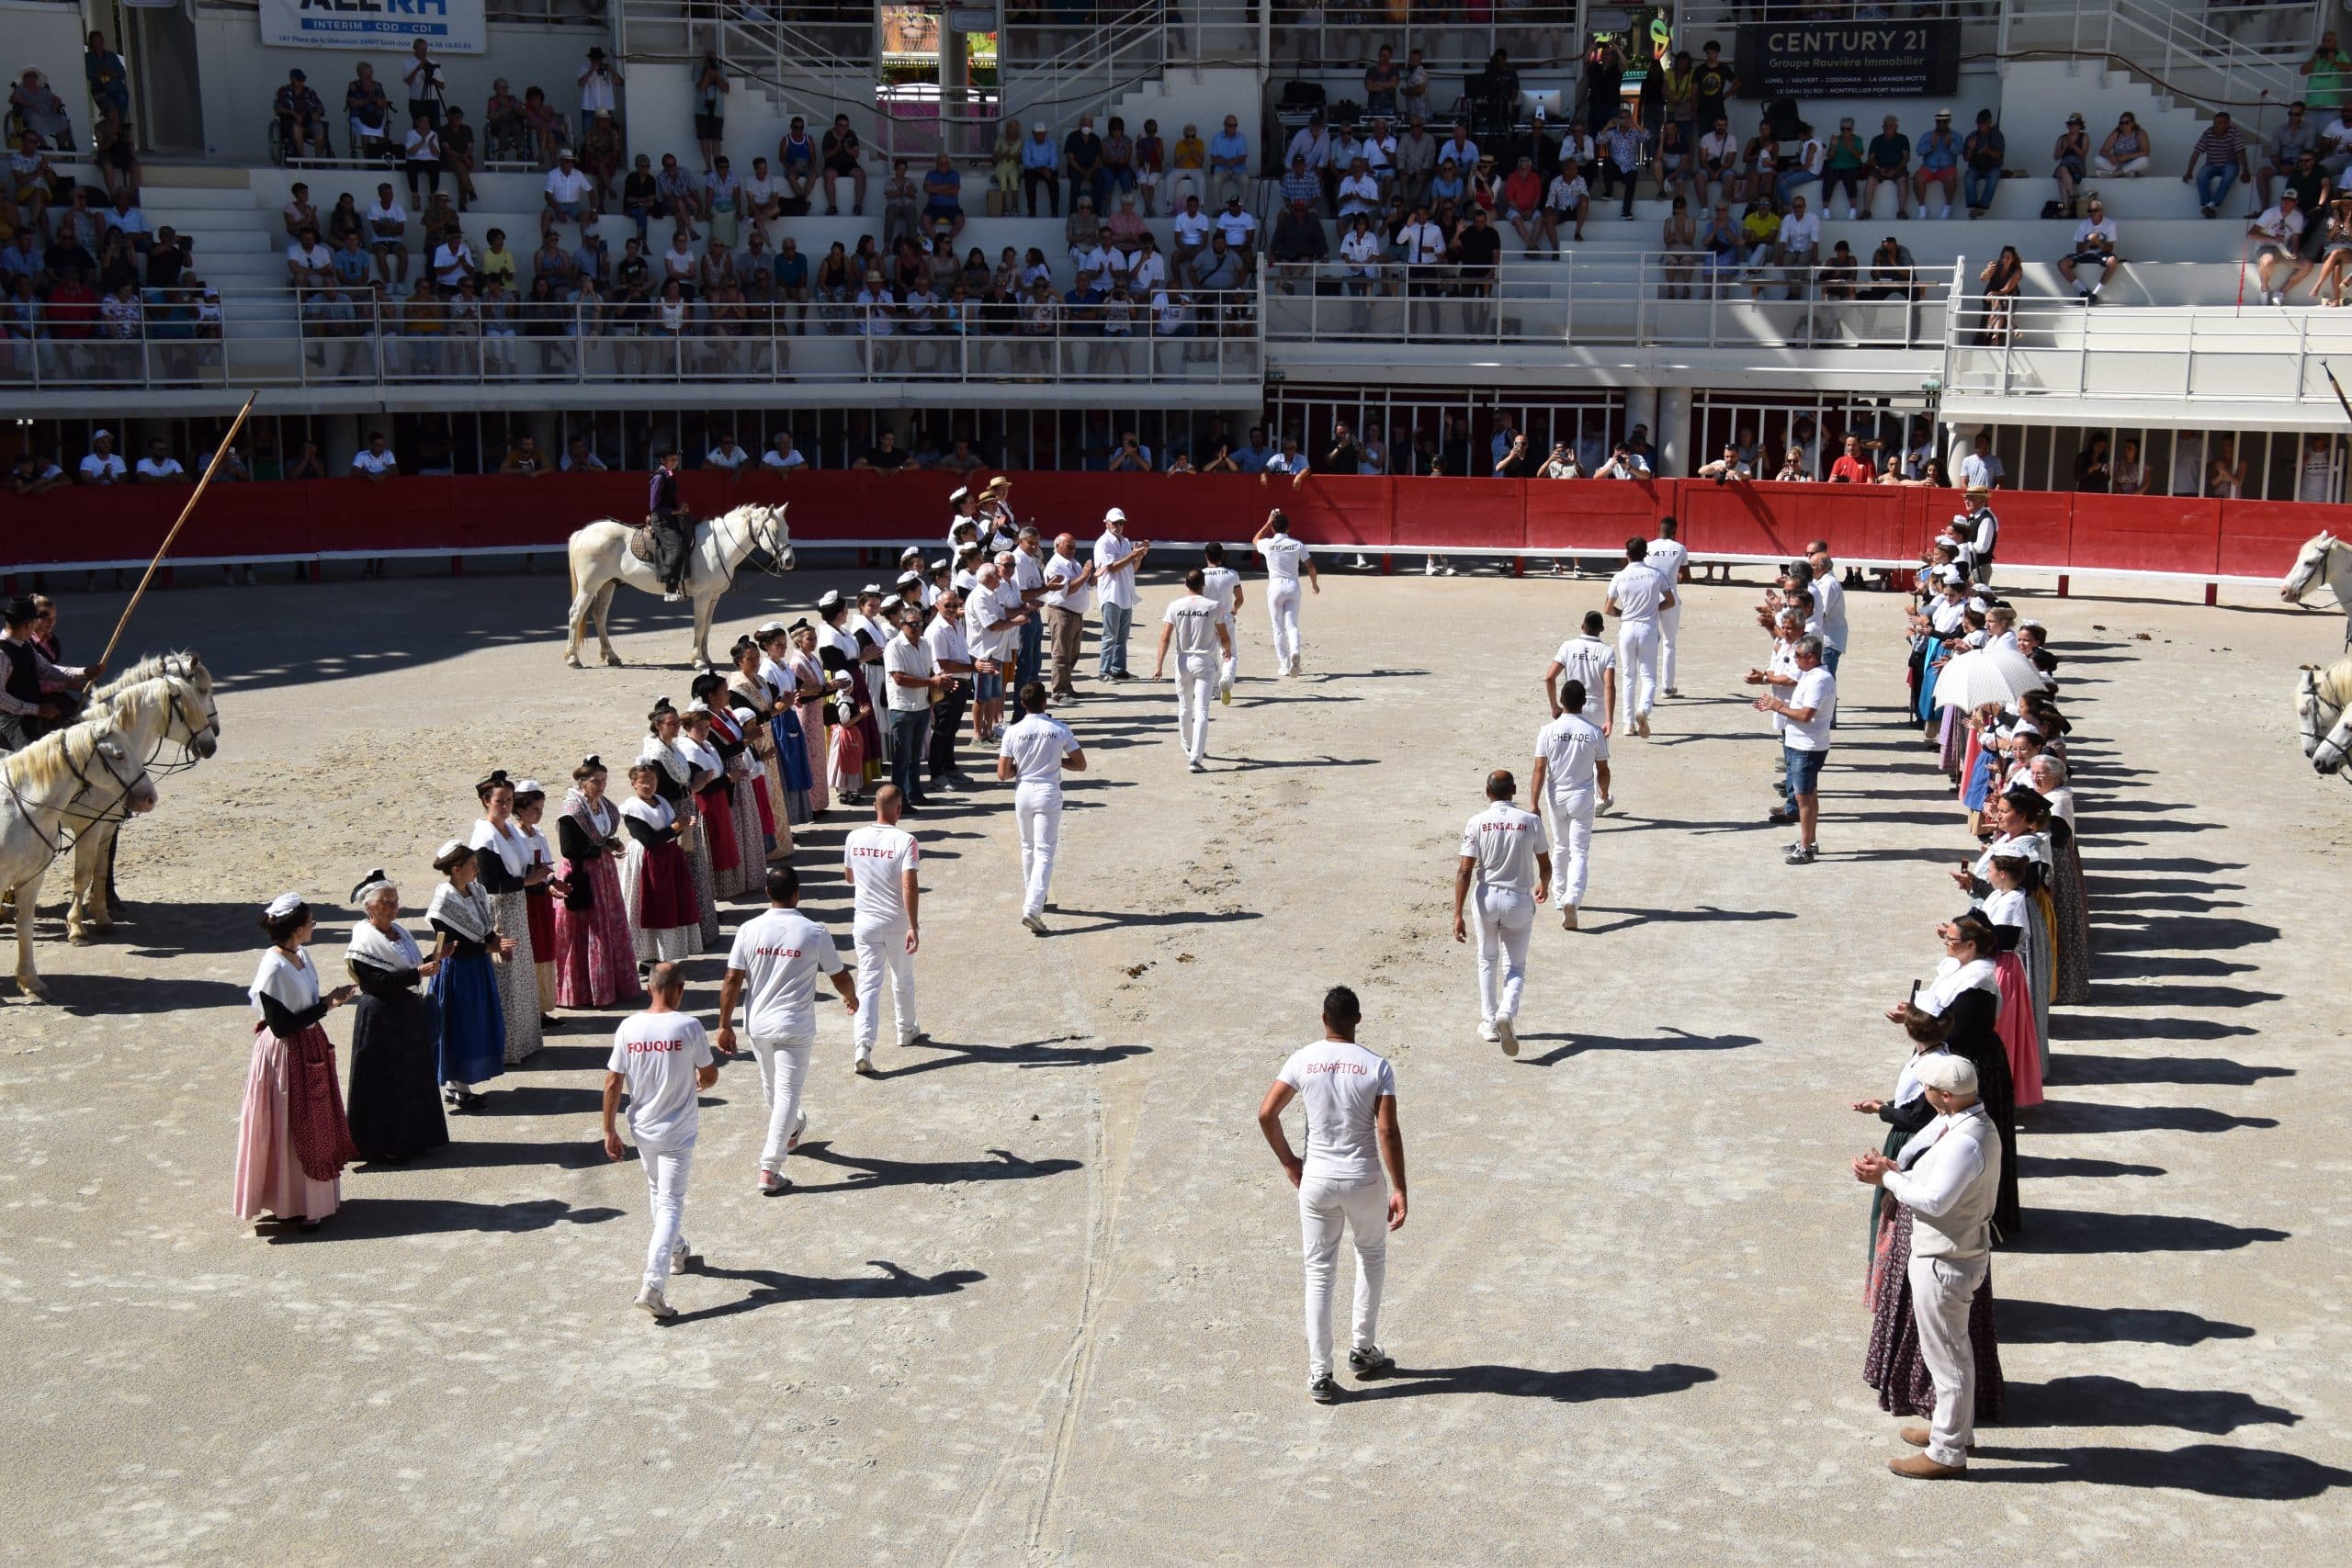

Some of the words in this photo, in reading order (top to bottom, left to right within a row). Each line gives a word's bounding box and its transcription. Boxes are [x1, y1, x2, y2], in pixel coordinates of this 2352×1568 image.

[313, 20, 363, 30] INTERIM
[375, 21, 399, 31] CDD
[412, 23, 432, 33] CDI
[1768, 30, 1896, 52] CENTURY
[1904, 29, 1927, 51] 21
[1769, 58, 1809, 70] Groupe
[1813, 57, 1860, 67] Rouvière
[1864, 56, 1924, 66] Immobilier
[1176, 609, 1209, 617] ALIAGA
[1572, 653, 1599, 662] FELIX
[1552, 732, 1590, 743] CHEKADE
[853, 847, 895, 860] ESTEVE
[756, 947, 802, 958] KHALED
[628, 1040, 683, 1054] FOUQUE
[1306, 1062, 1368, 1076] BENAFITOU
